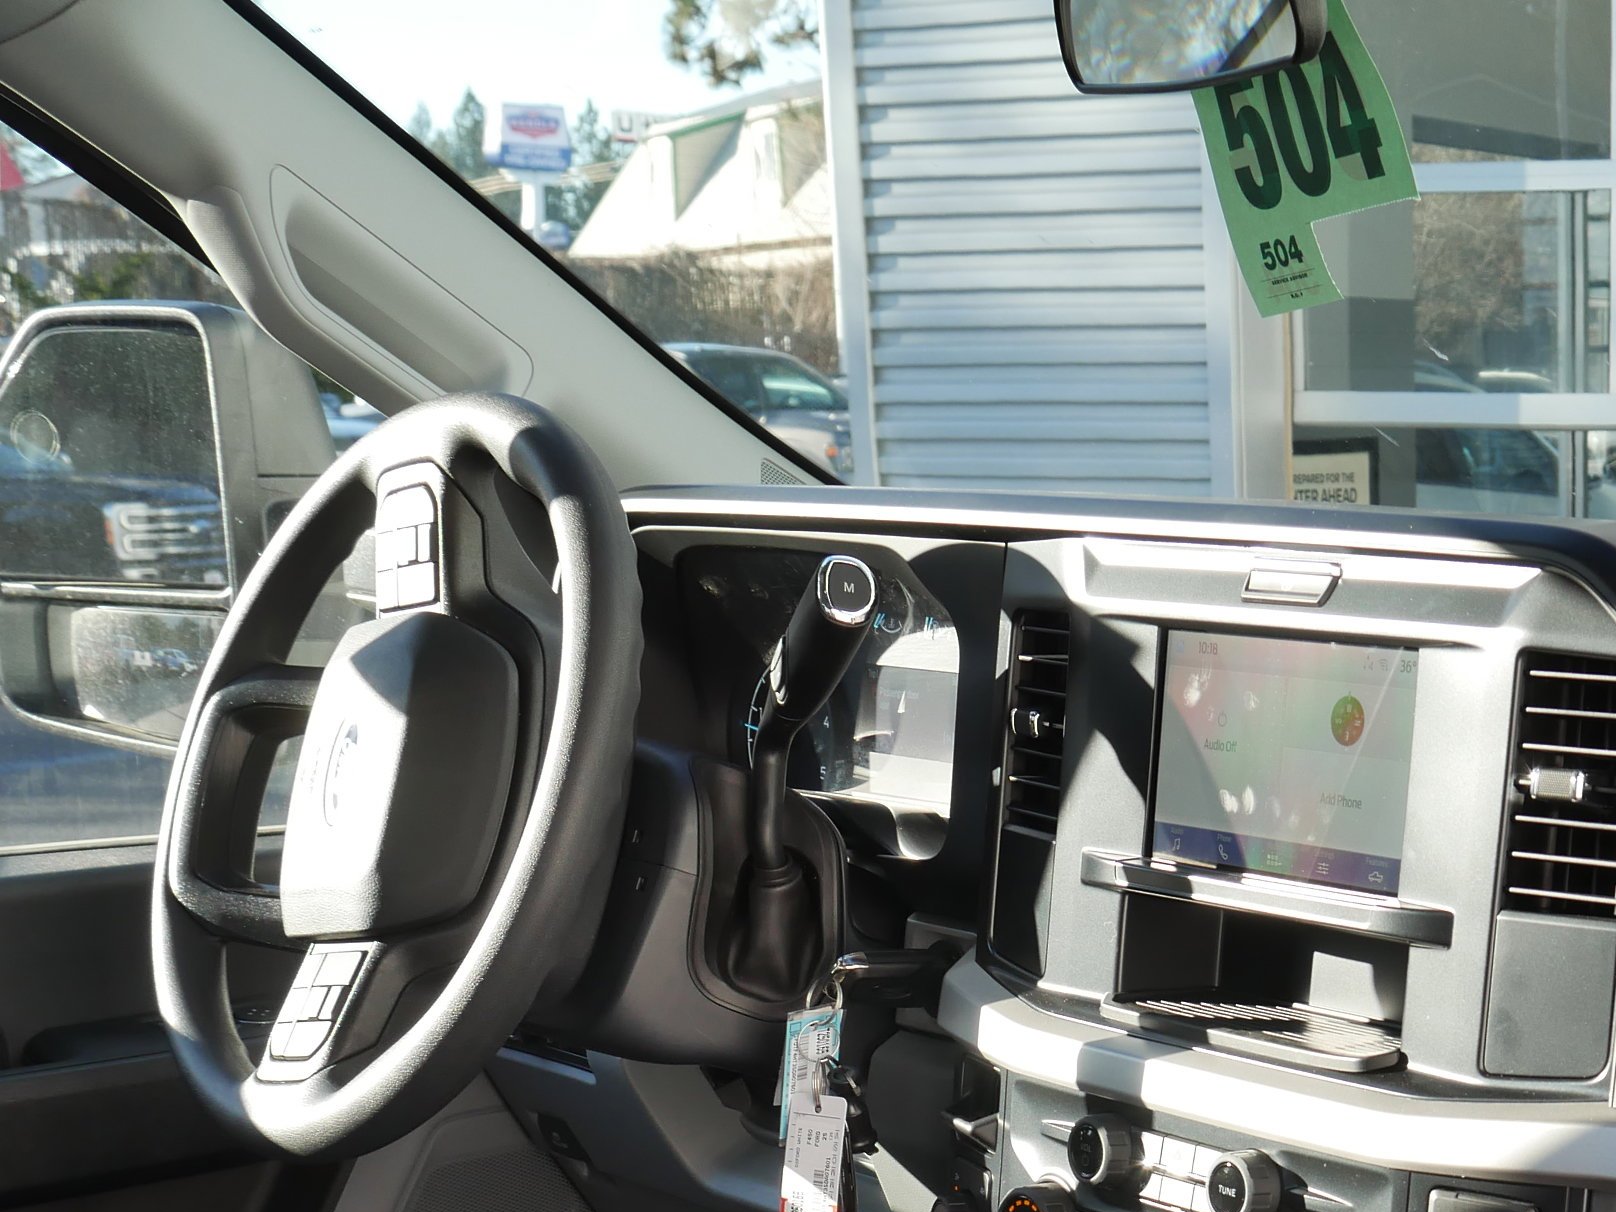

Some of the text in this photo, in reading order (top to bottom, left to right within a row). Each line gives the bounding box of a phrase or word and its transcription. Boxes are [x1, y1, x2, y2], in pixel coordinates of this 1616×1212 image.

[1213, 31, 1386, 210] 504
[1259, 234, 1304, 271] 504
[1325, 473, 1341, 483] FOR
[1341, 472, 1355, 483] THE
[1320, 487, 1358, 503] AHEAD
[843, 581, 855, 594] M
[823, 715, 830, 729] 4
[1204, 738, 1225, 752] Audio
[820, 765, 827, 780] 5
[1337, 794, 1363, 810] Phone
[1218, 1184, 1237, 1198] TUNE
